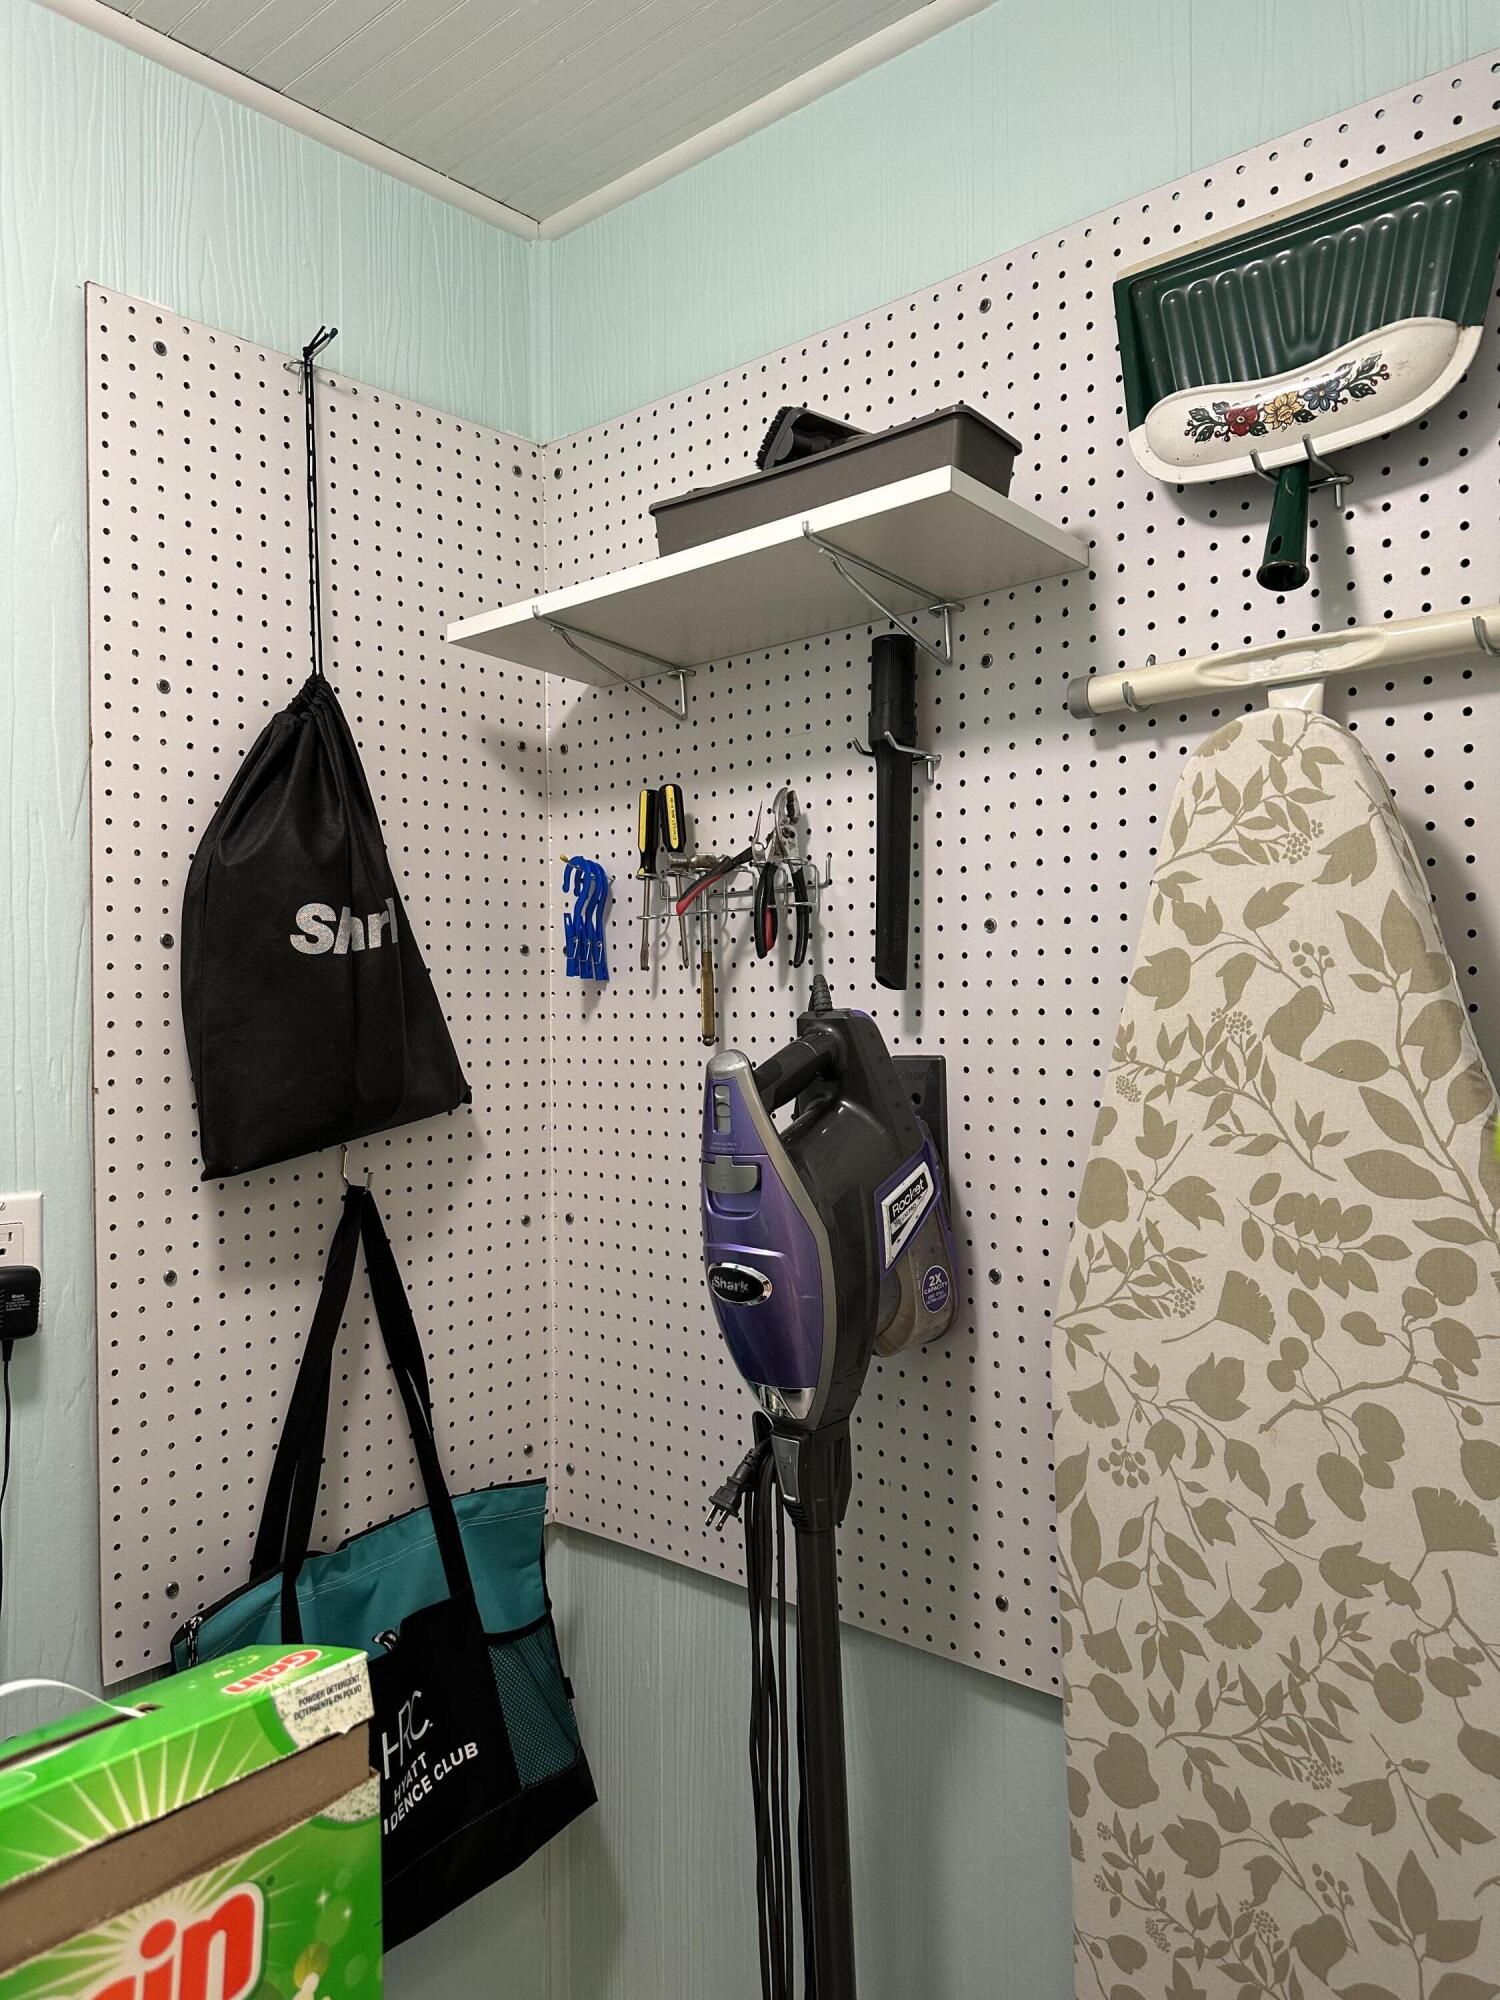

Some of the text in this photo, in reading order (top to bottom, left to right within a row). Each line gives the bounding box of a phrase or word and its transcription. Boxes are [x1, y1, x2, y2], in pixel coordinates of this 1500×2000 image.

[892, 1178, 925, 1217] Rocket
[711, 1276, 749, 1292] Shark
[928, 1272, 942, 1287] 2X
[222, 1650, 321, 1693] Gain
[293, 1684, 362, 1720] DETERGENTE EN POLVO
[298, 1674, 360, 1707] POWDER DETERGENT
[384, 1742, 479, 1835] IDENCE CLUB
[394, 1752, 427, 1805] HYATT
